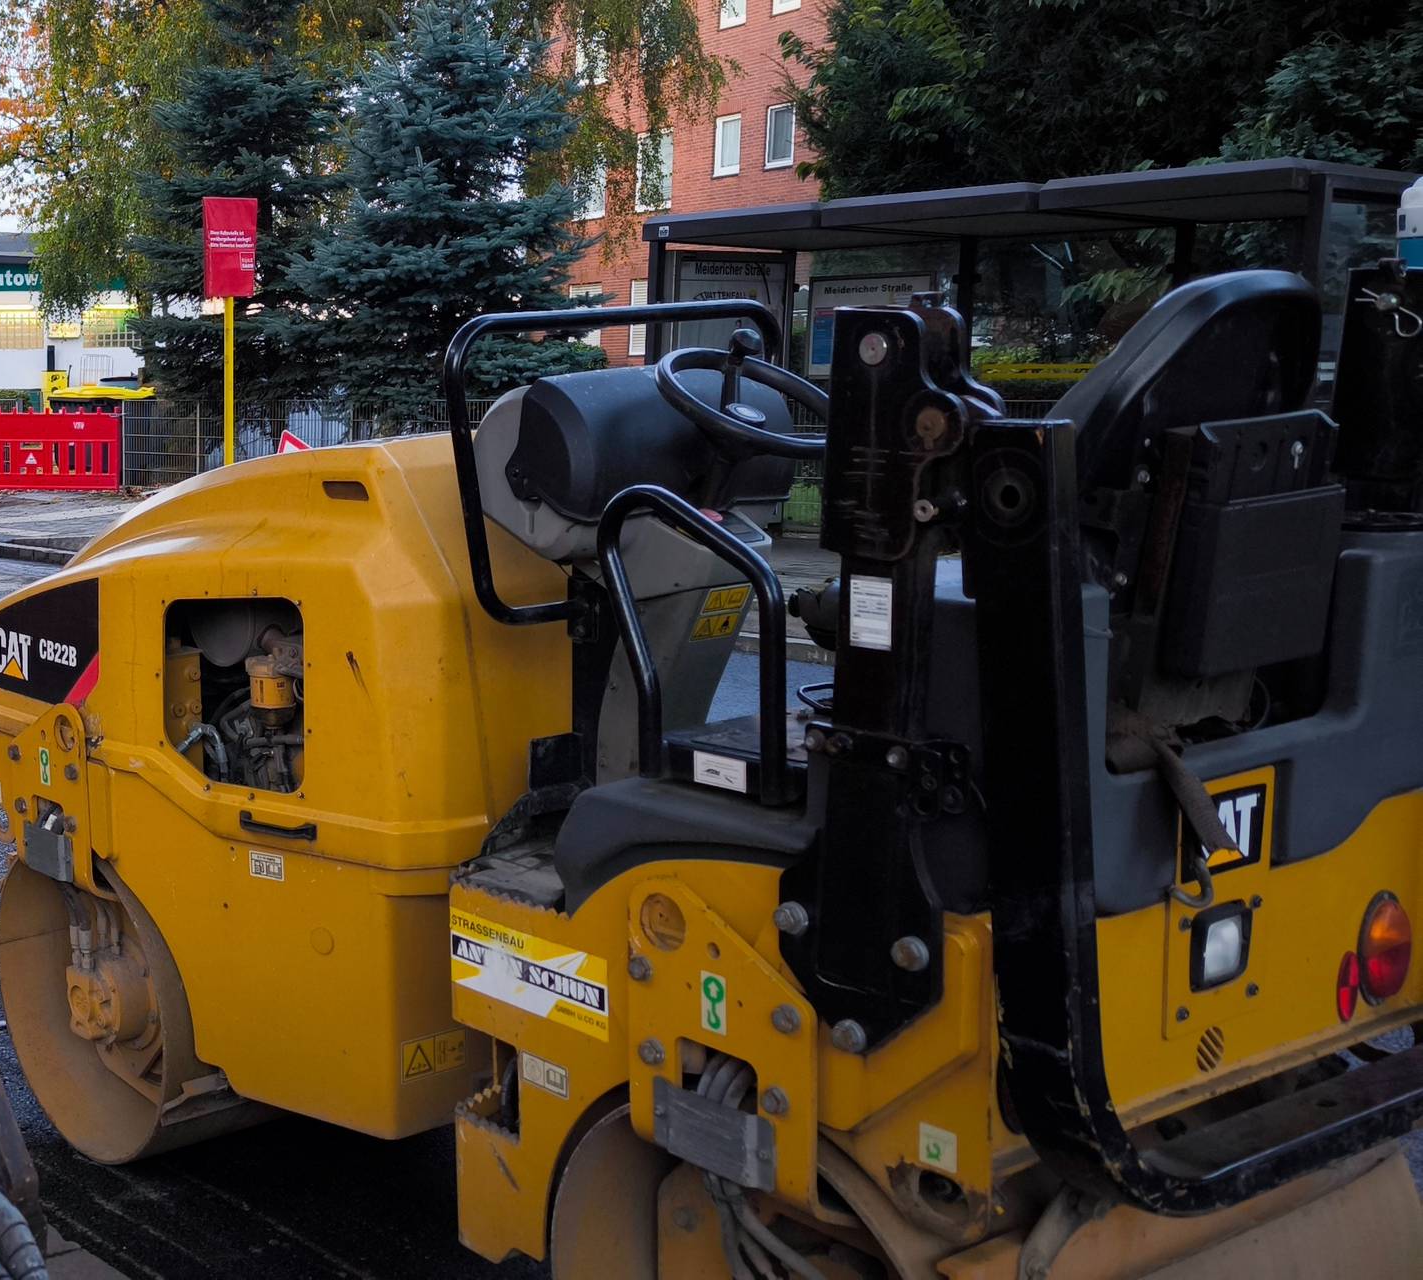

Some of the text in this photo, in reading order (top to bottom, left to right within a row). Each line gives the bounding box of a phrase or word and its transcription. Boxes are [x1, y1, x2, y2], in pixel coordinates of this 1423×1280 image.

[695, 262, 743, 276] Meidericher
[824, 283, 913, 295] Meidericher Straße
[39, 638, 77, 667] CB22B
[1211, 793, 1259, 858] AT
[451, 915, 524, 949] STRASSENBAU
